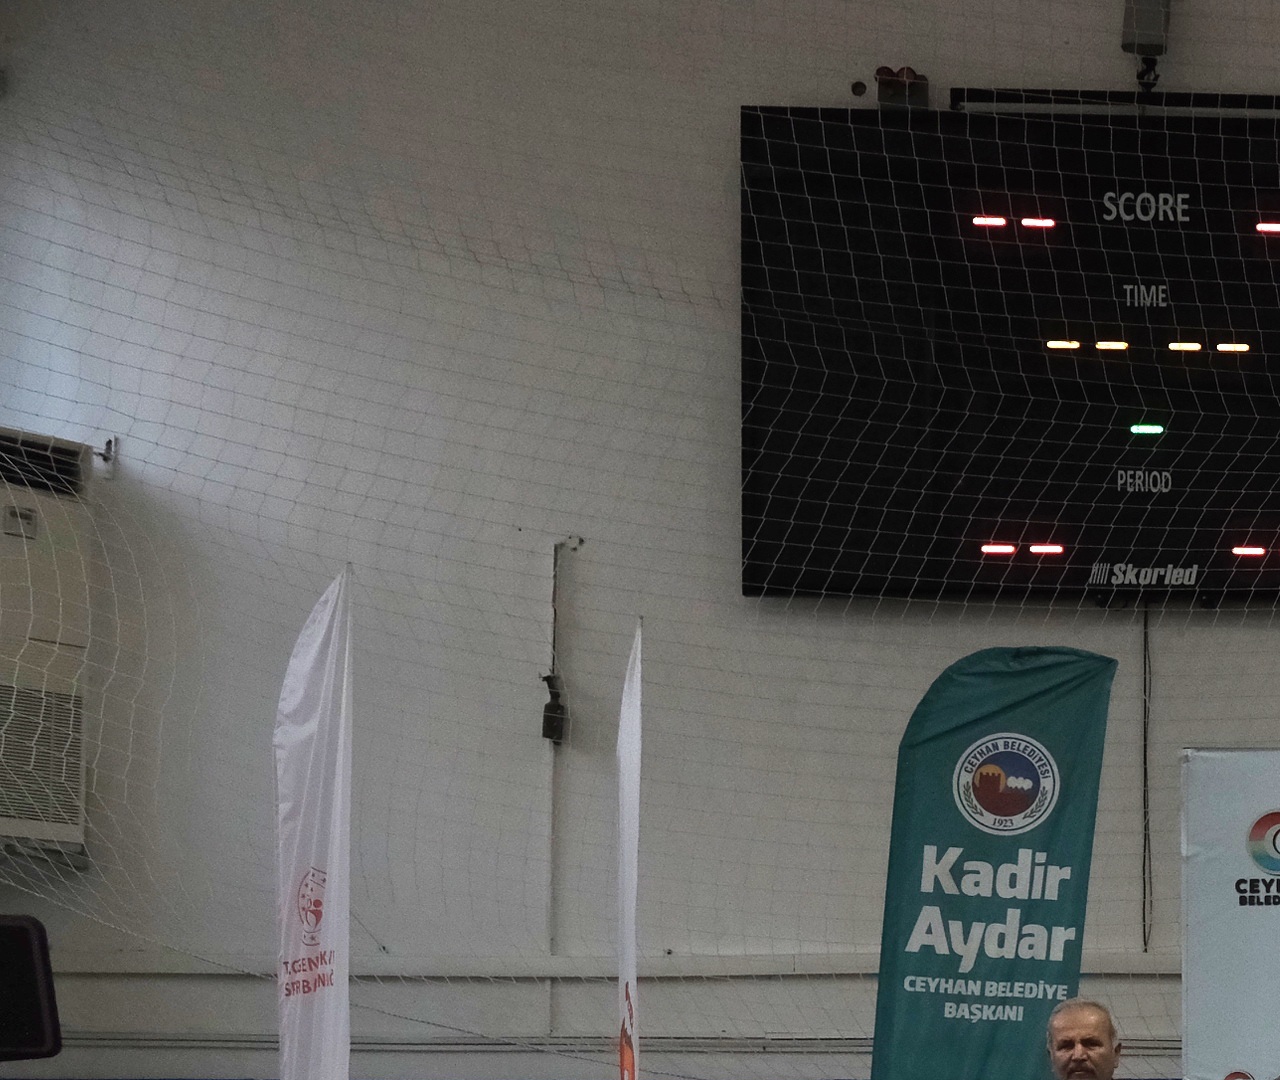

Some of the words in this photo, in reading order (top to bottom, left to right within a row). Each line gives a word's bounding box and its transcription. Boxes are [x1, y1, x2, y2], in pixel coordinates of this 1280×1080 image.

[1102, 192, 1190, 223] SCORE
[1123, 285, 1167, 308] TIME
[1117, 470, 1172, 493] PERIOD
[1111, 563, 1198, 586] Skorled
[964, 741, 1000, 775] CEYHAN
[1003, 739, 1051, 780] BELEDİYESİ
[992, 817, 1014, 829] 1923
[920, 844, 1071, 901] Kadir
[905, 905, 1076, 973] Aydar
[903, 975, 981, 997] CEYHAN
[984, 979, 1068, 1001] BELEDİYE
[943, 1001, 1024, 1023] BAŞKANI
